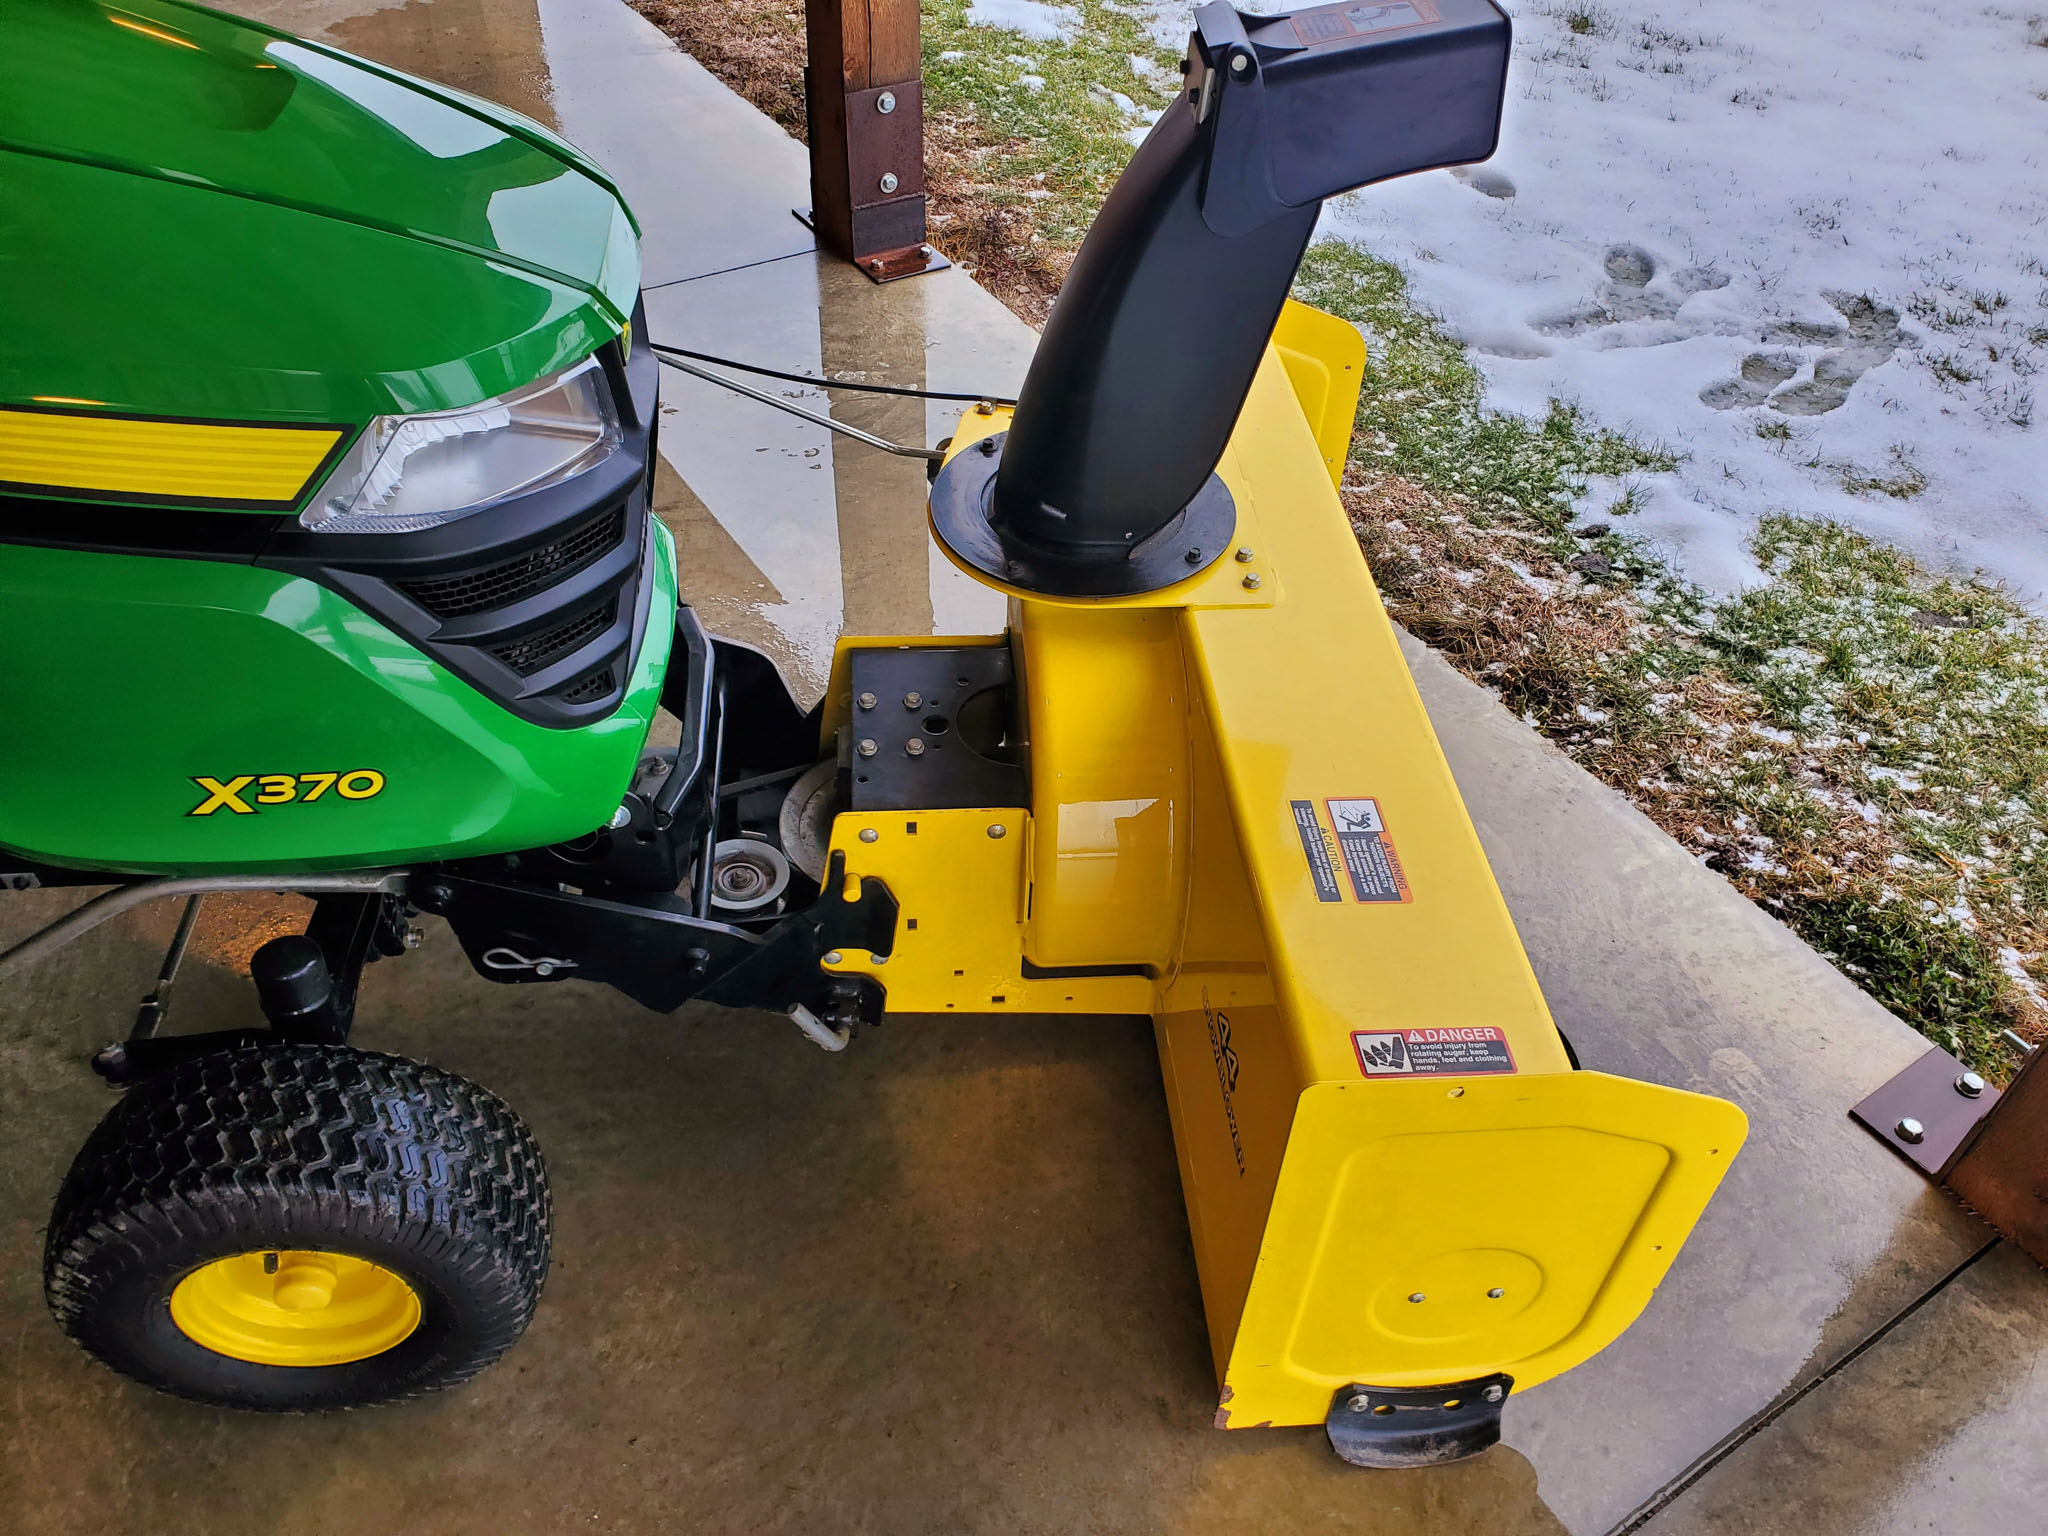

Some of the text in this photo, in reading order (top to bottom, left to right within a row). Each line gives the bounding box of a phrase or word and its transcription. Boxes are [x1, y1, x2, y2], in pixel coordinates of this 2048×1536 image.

[184, 768, 387, 817] X370
[1323, 835, 1342, 872] CAUTION
[1369, 841, 1389, 888] THROWN OBJECTS
[1373, 836, 1398, 893] TO AVOID INJURY FROM
[1387, 850, 1408, 890] WARNING
[1425, 1028, 1497, 1042] DANGER
[1444, 1042, 1466, 1051] injury
[1411, 1050, 1442, 1058] rotating
[1475, 1055, 1508, 1063] clothing
